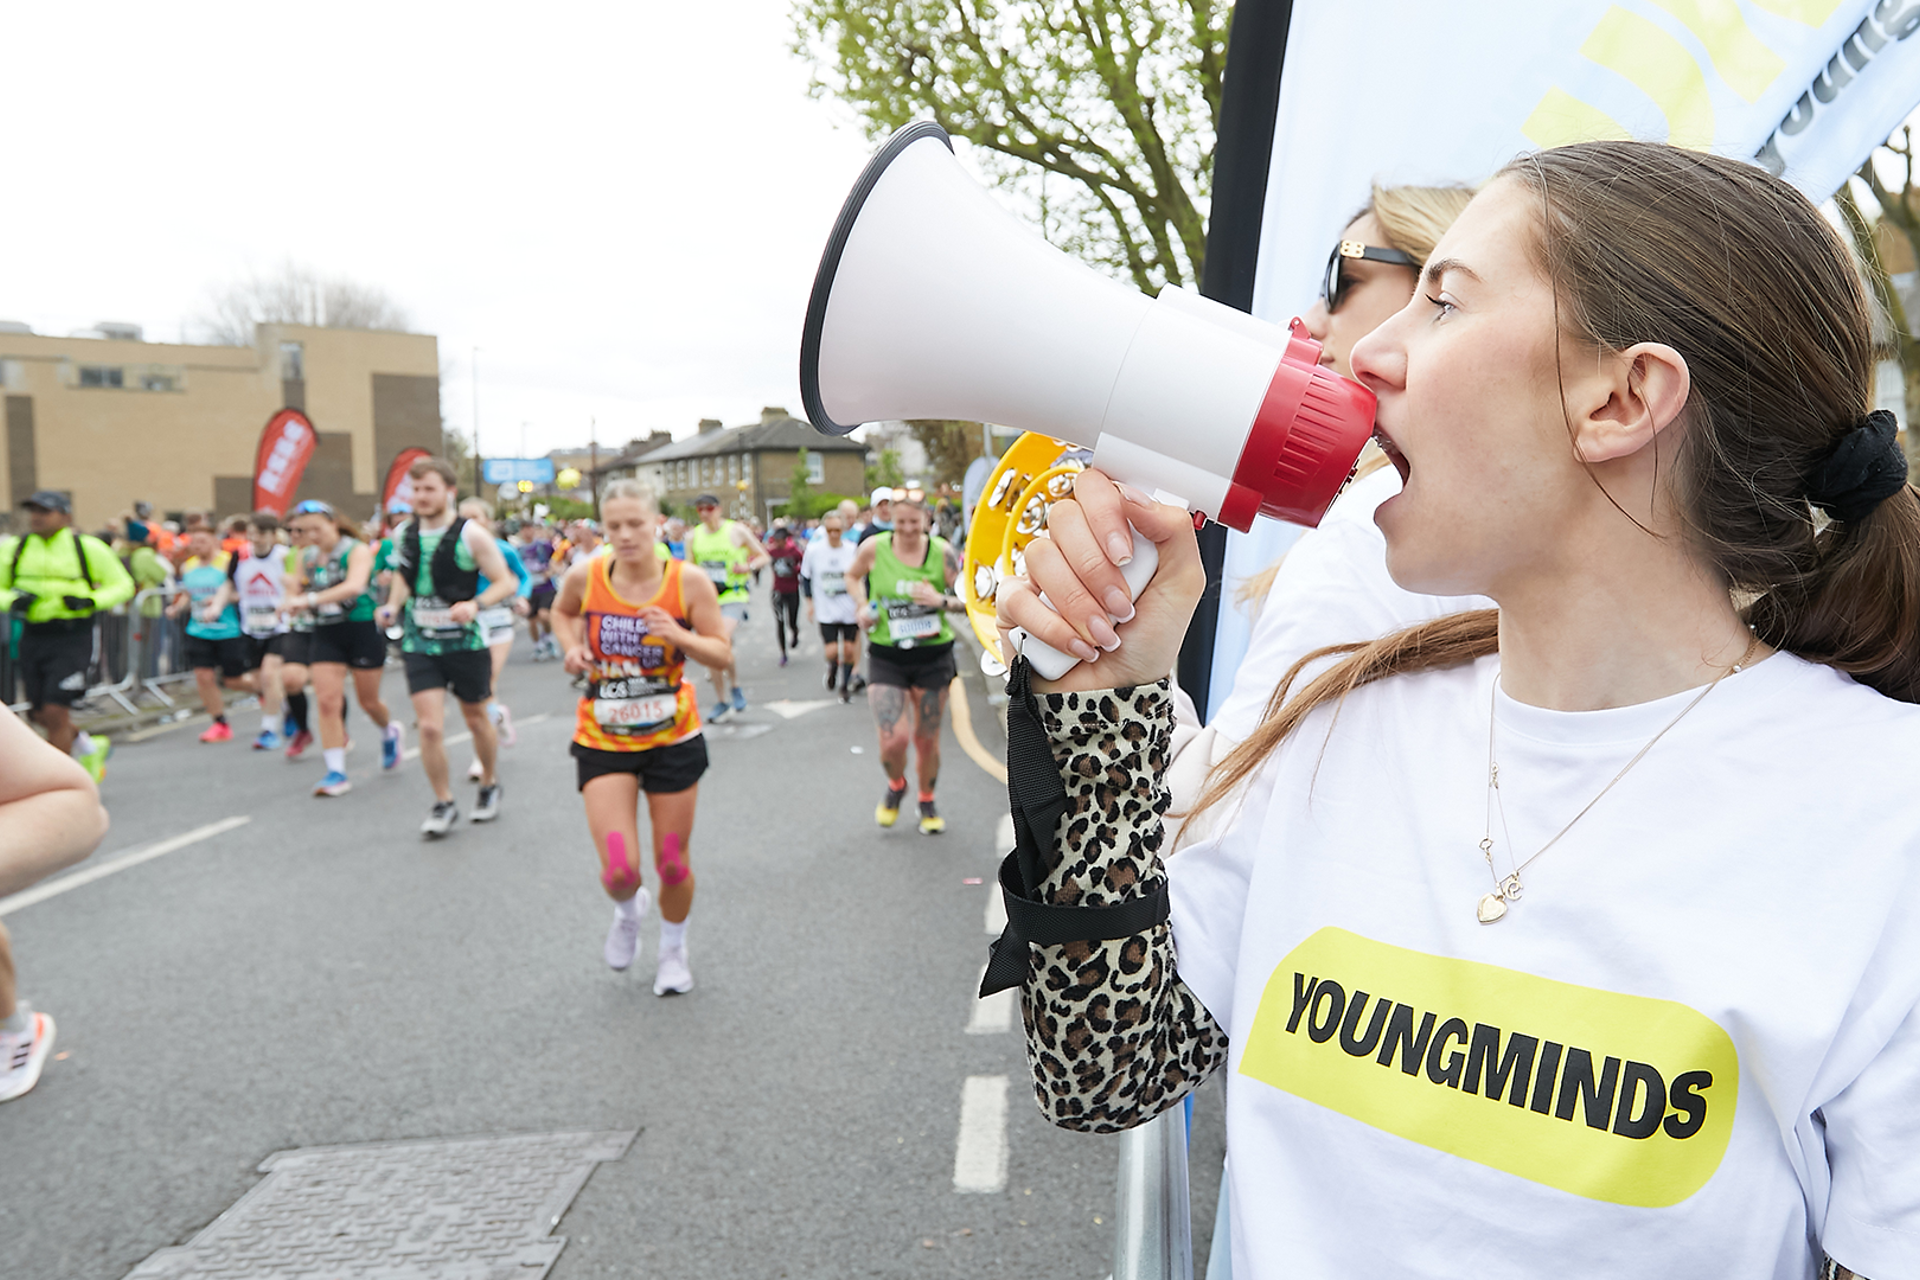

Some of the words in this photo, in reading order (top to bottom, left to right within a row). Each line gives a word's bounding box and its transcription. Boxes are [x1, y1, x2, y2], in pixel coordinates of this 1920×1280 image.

[600, 630, 640, 644] WITH
[601, 642, 664, 658] CANCER
[609, 702, 664, 723] 26015
[1285, 972, 1713, 1140] YOUNGMINDS
